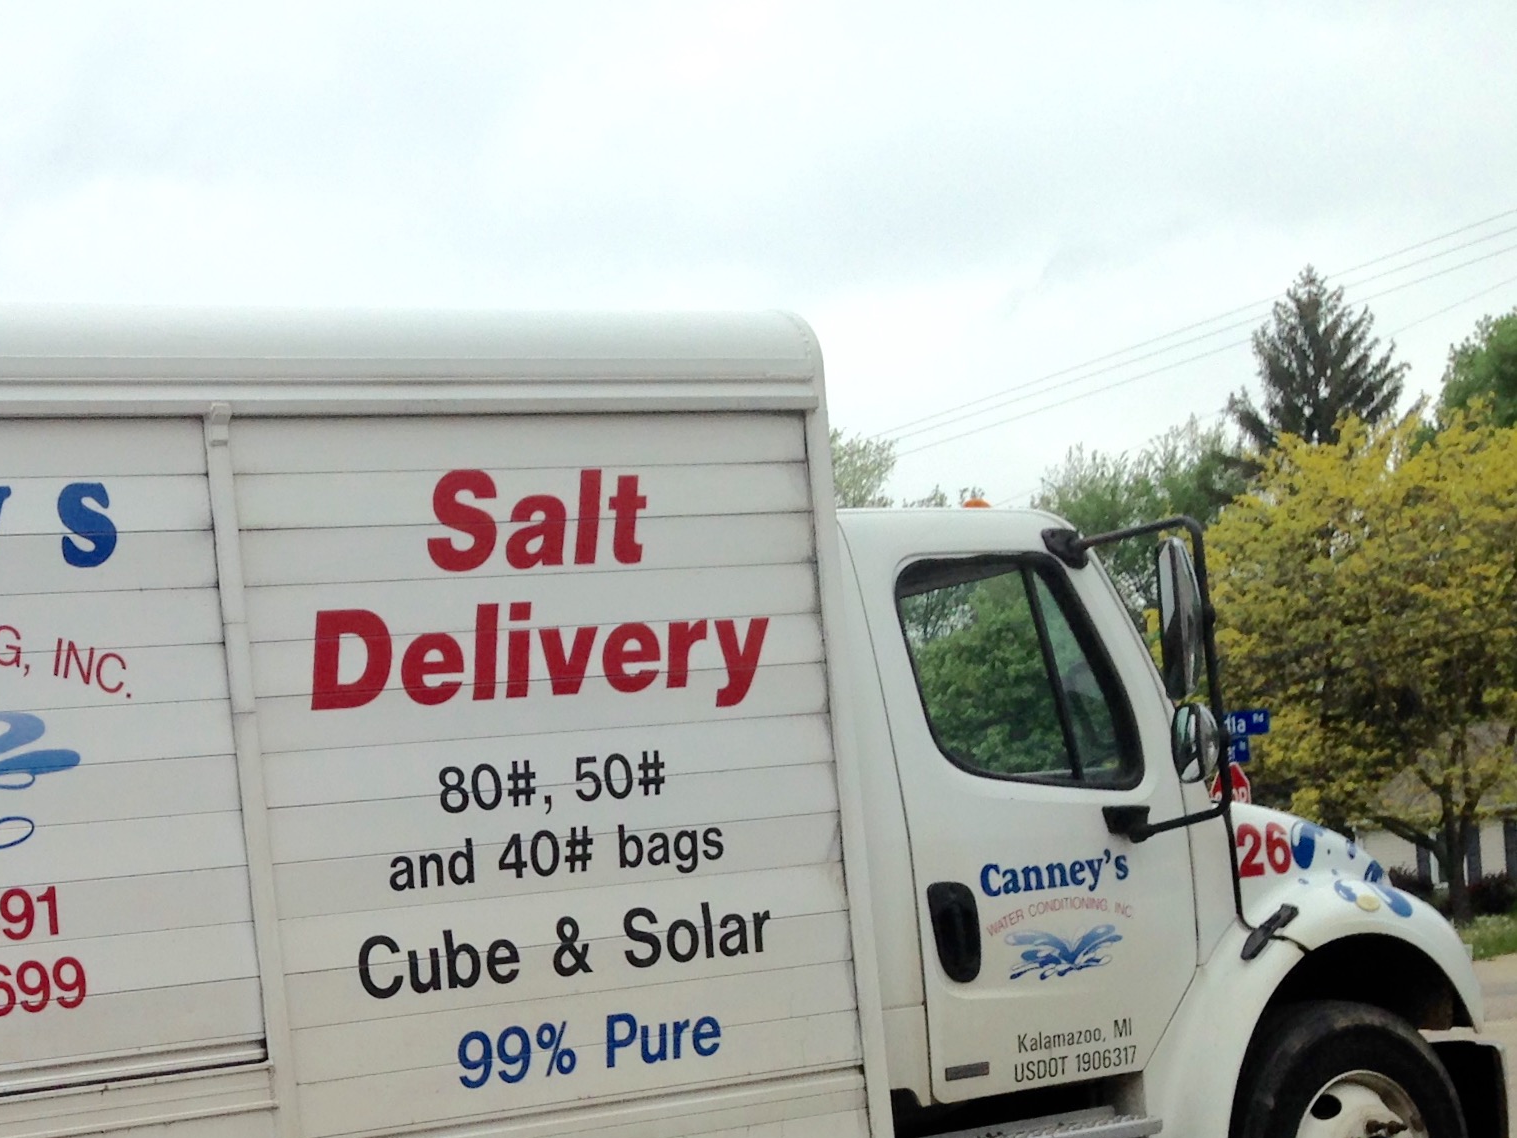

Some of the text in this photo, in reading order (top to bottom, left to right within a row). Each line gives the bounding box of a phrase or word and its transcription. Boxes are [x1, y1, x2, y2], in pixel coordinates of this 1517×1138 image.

[426, 468, 648, 572] Salt
[53, 637, 134, 698] INC.
[310, 601, 769, 711] Delivery
[438, 750, 666, 815] 80#, 50#
[389, 823, 724, 892] and 40# bags
[980, 849, 1129, 897] Canney's
[1236, 821, 1292, 878] 26
[358, 901, 771, 1000] Cube & Solar
[986, 909, 1024, 936] WATER
[459, 1013, 721, 1088] 99% Pure
[1014, 1045, 1137, 1083] USDOT 1906317
[1017, 1017, 1133, 1053] Kalamazoo, MI
